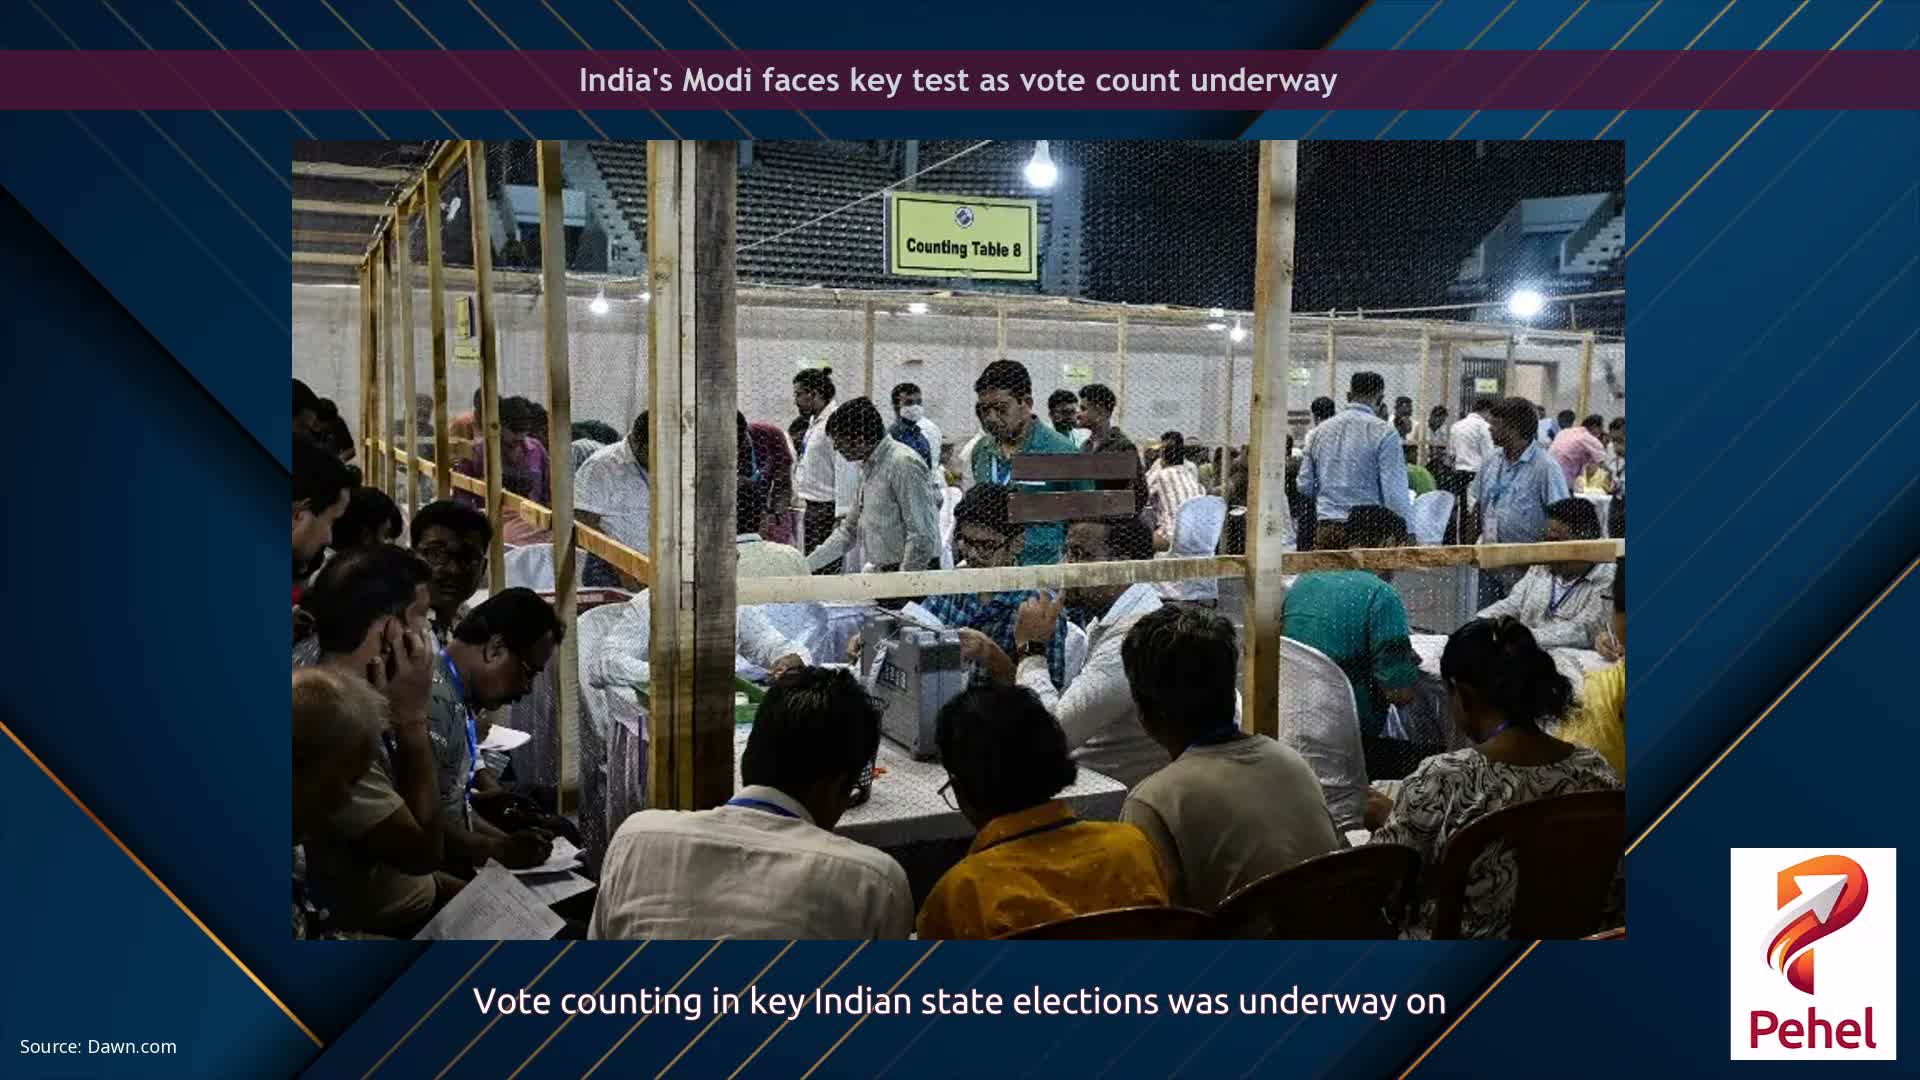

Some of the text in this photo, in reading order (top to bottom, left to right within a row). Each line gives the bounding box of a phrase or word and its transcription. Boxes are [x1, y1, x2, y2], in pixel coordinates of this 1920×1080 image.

[906, 237, 1022, 259] Counting Table 8
